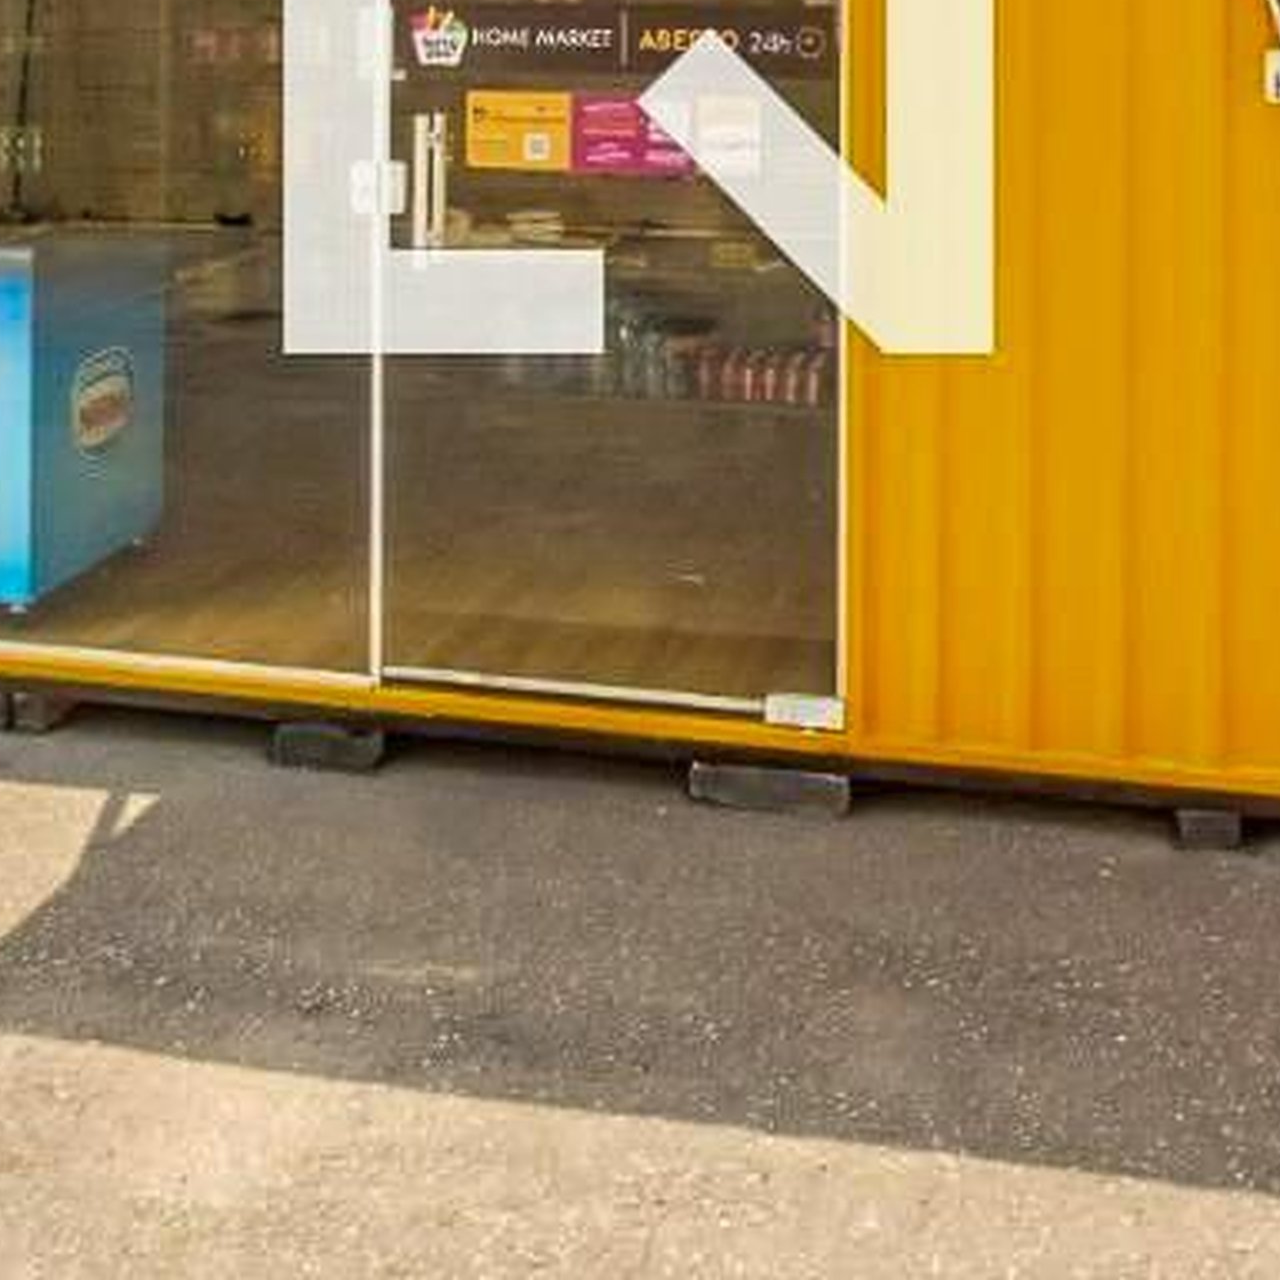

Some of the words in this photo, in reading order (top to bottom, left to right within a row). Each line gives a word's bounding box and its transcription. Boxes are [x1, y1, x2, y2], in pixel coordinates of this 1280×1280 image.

[472, 27, 529, 48] HOME
[535, 28, 614, 48] MARKET
[639, 28, 740, 52] ABEO
